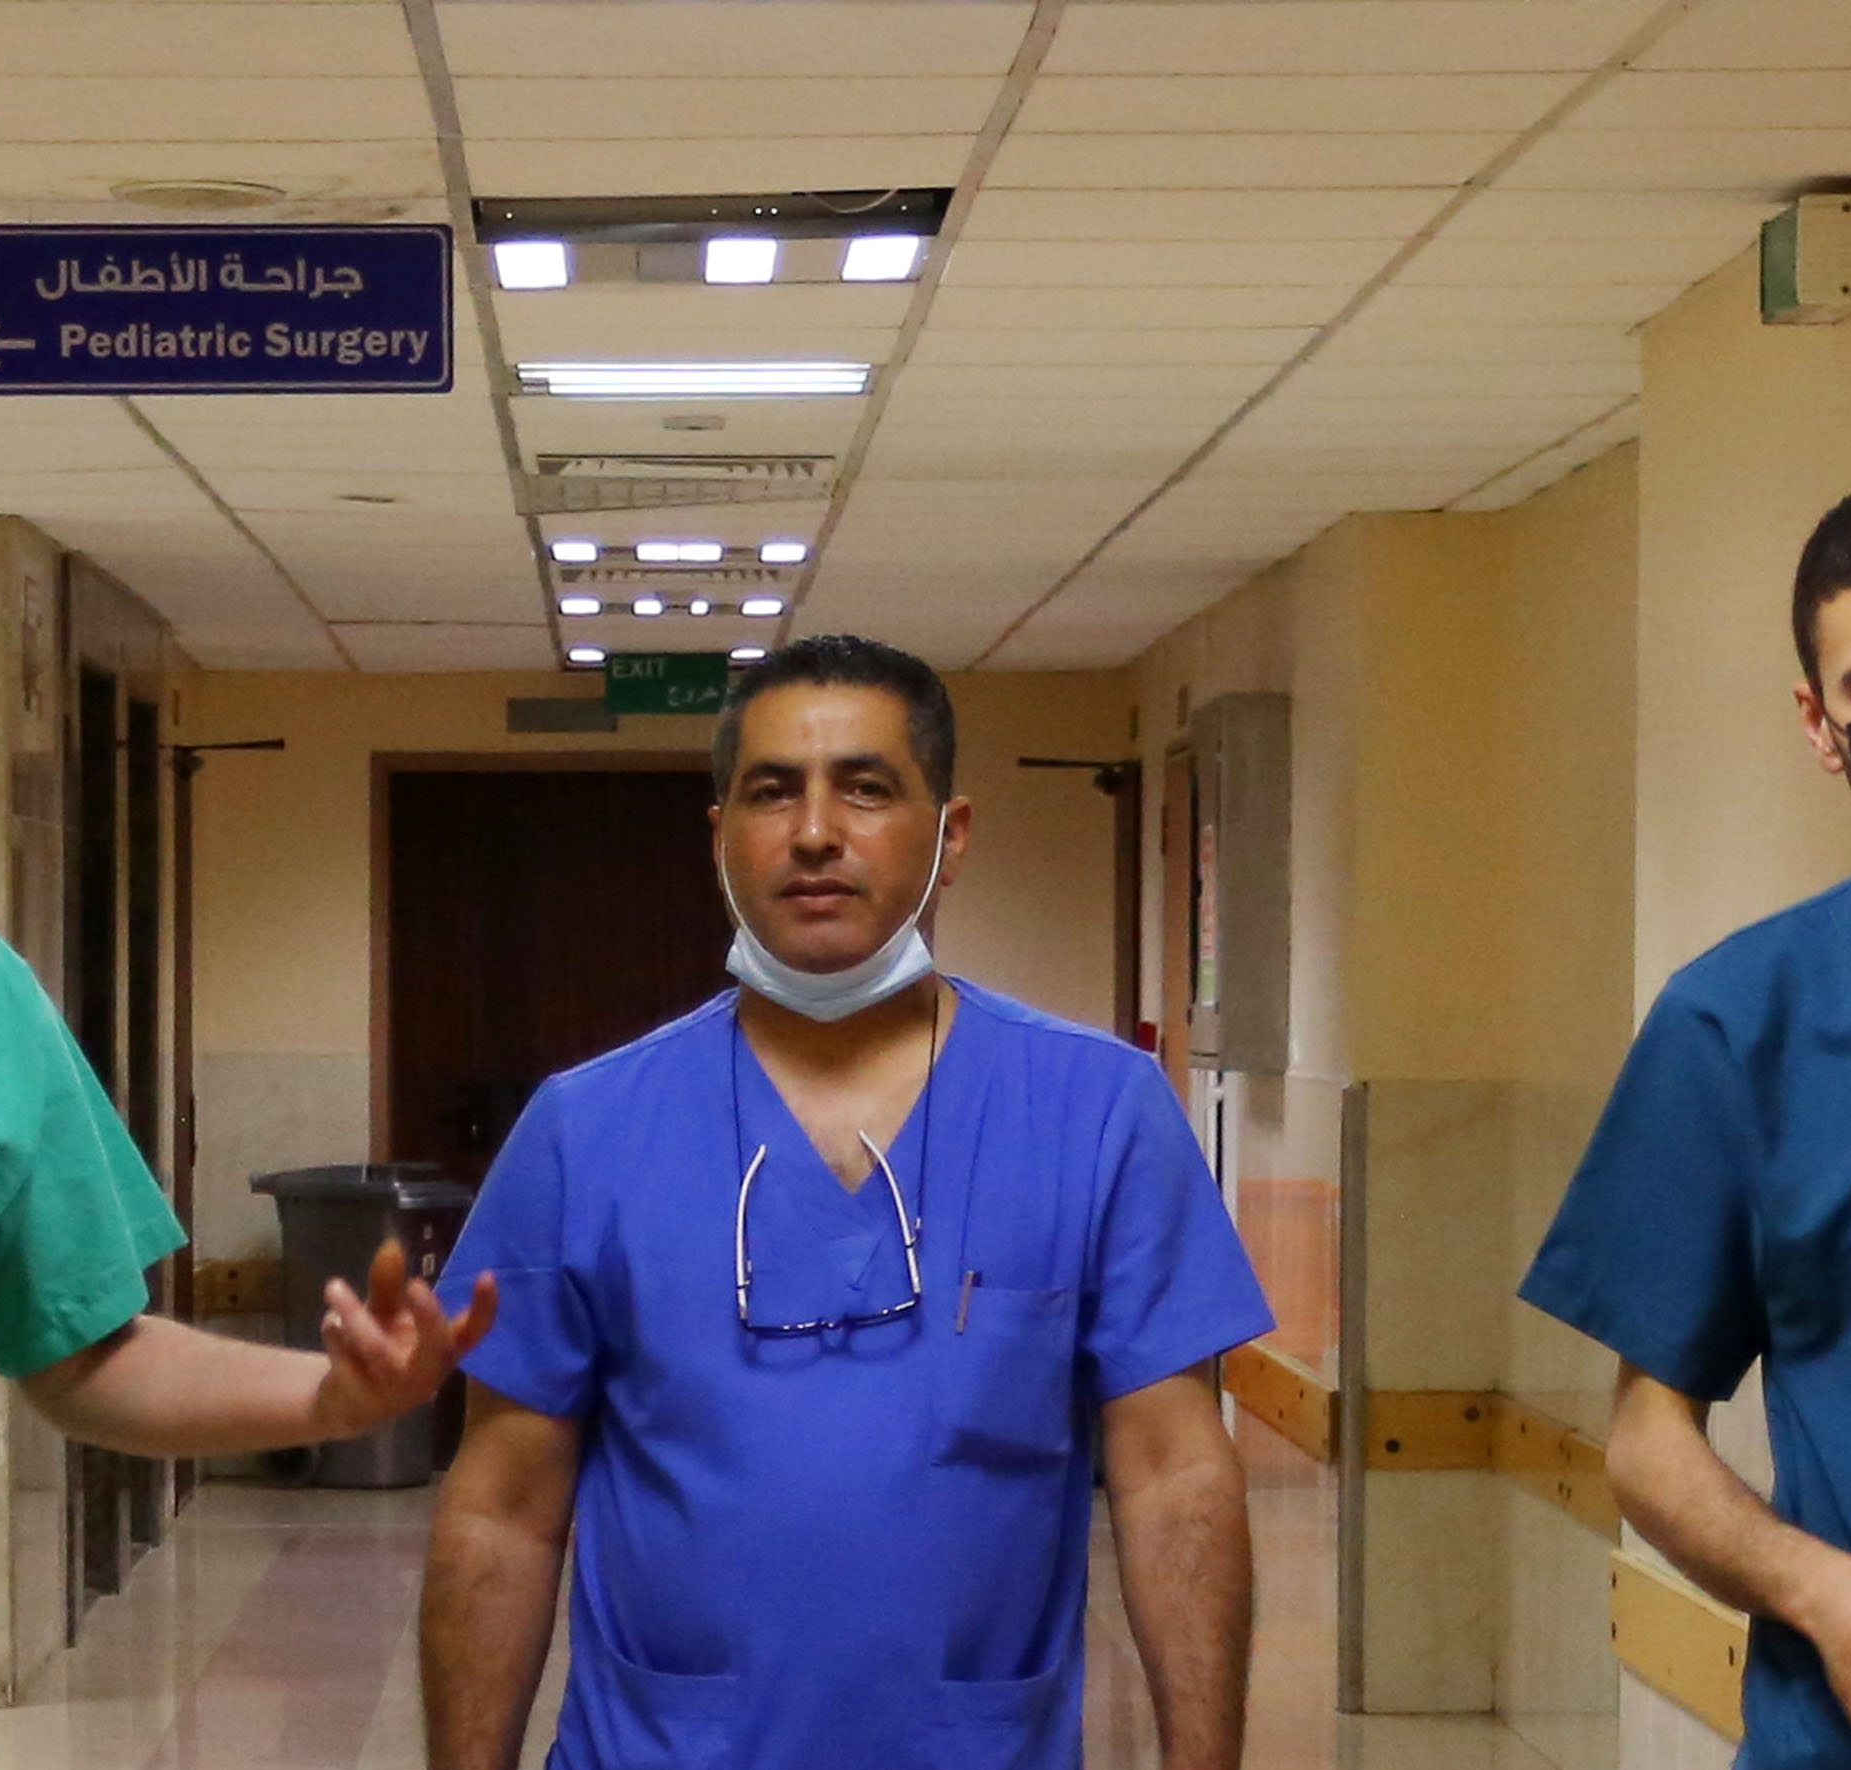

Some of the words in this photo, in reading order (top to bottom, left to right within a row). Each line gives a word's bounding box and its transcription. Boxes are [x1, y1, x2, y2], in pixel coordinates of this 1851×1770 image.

[36, 252, 207, 300] الأطفال
[219, 253, 364, 299] جراحة
[60, 323, 251, 358] Pediatric
[265, 322, 428, 365] Surgery
[612, 657, 668, 679] EXIT
